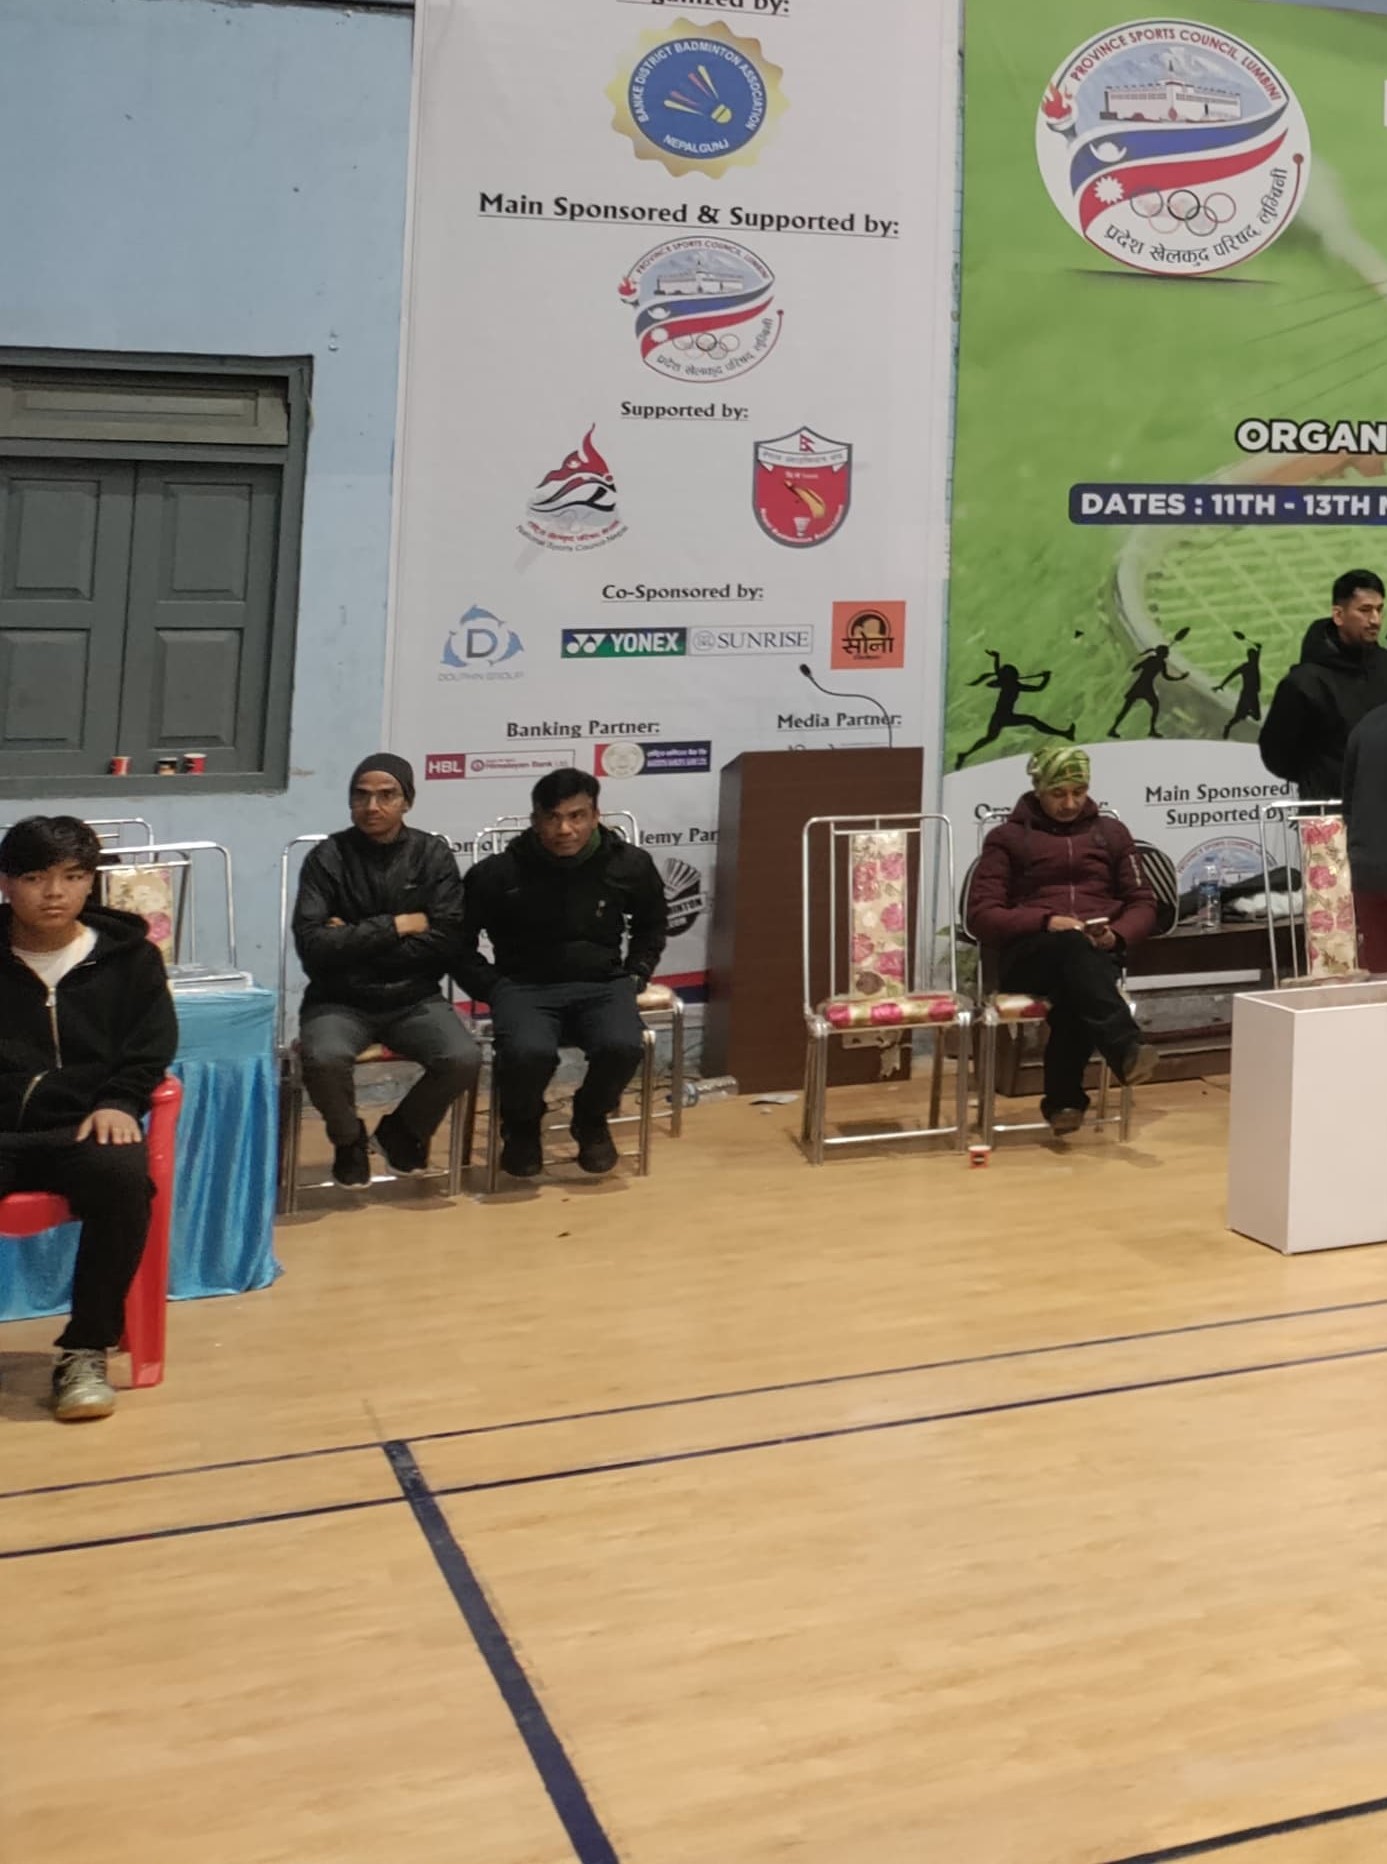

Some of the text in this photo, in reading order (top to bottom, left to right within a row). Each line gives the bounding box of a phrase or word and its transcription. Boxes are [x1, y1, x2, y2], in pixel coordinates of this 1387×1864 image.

[1071, 28, 1283, 101] PROVINCE SPORTS COUNCIL LUMBINI
[632, 41, 764, 131] BANKE DISTRICT BADMINTON ASSOCIATION
[663, 134, 730, 154] NEPALGUNJ
[479, 192, 900, 236] Main Sponsored & Supported by:
[1104, 224, 1145, 255] प्रदेश
[1150, 246, 1211, 267] खेलकुद
[1213, 223, 1262, 257] परिषद
[620, 401, 750, 420] Supported by:
[1080, 493, 1186, 516] DATES
[1209, 494, 1277, 517] 11TH
[1303, 495, 1371, 518] 13TH
[601, 584, 764, 601] Co-Sponsored by:
[610, 632, 680, 653] YONEX
[717, 630, 810, 649] SUNRISE
[841, 631, 895, 655] सोना
[506, 720, 660, 738] Banking Partner:
[777, 712, 903, 729] Media Partner:
[428, 761, 463, 774] HBL
[1145, 780, 1290, 802] Main Sponsored
[1165, 804, 1260, 826] Supported
